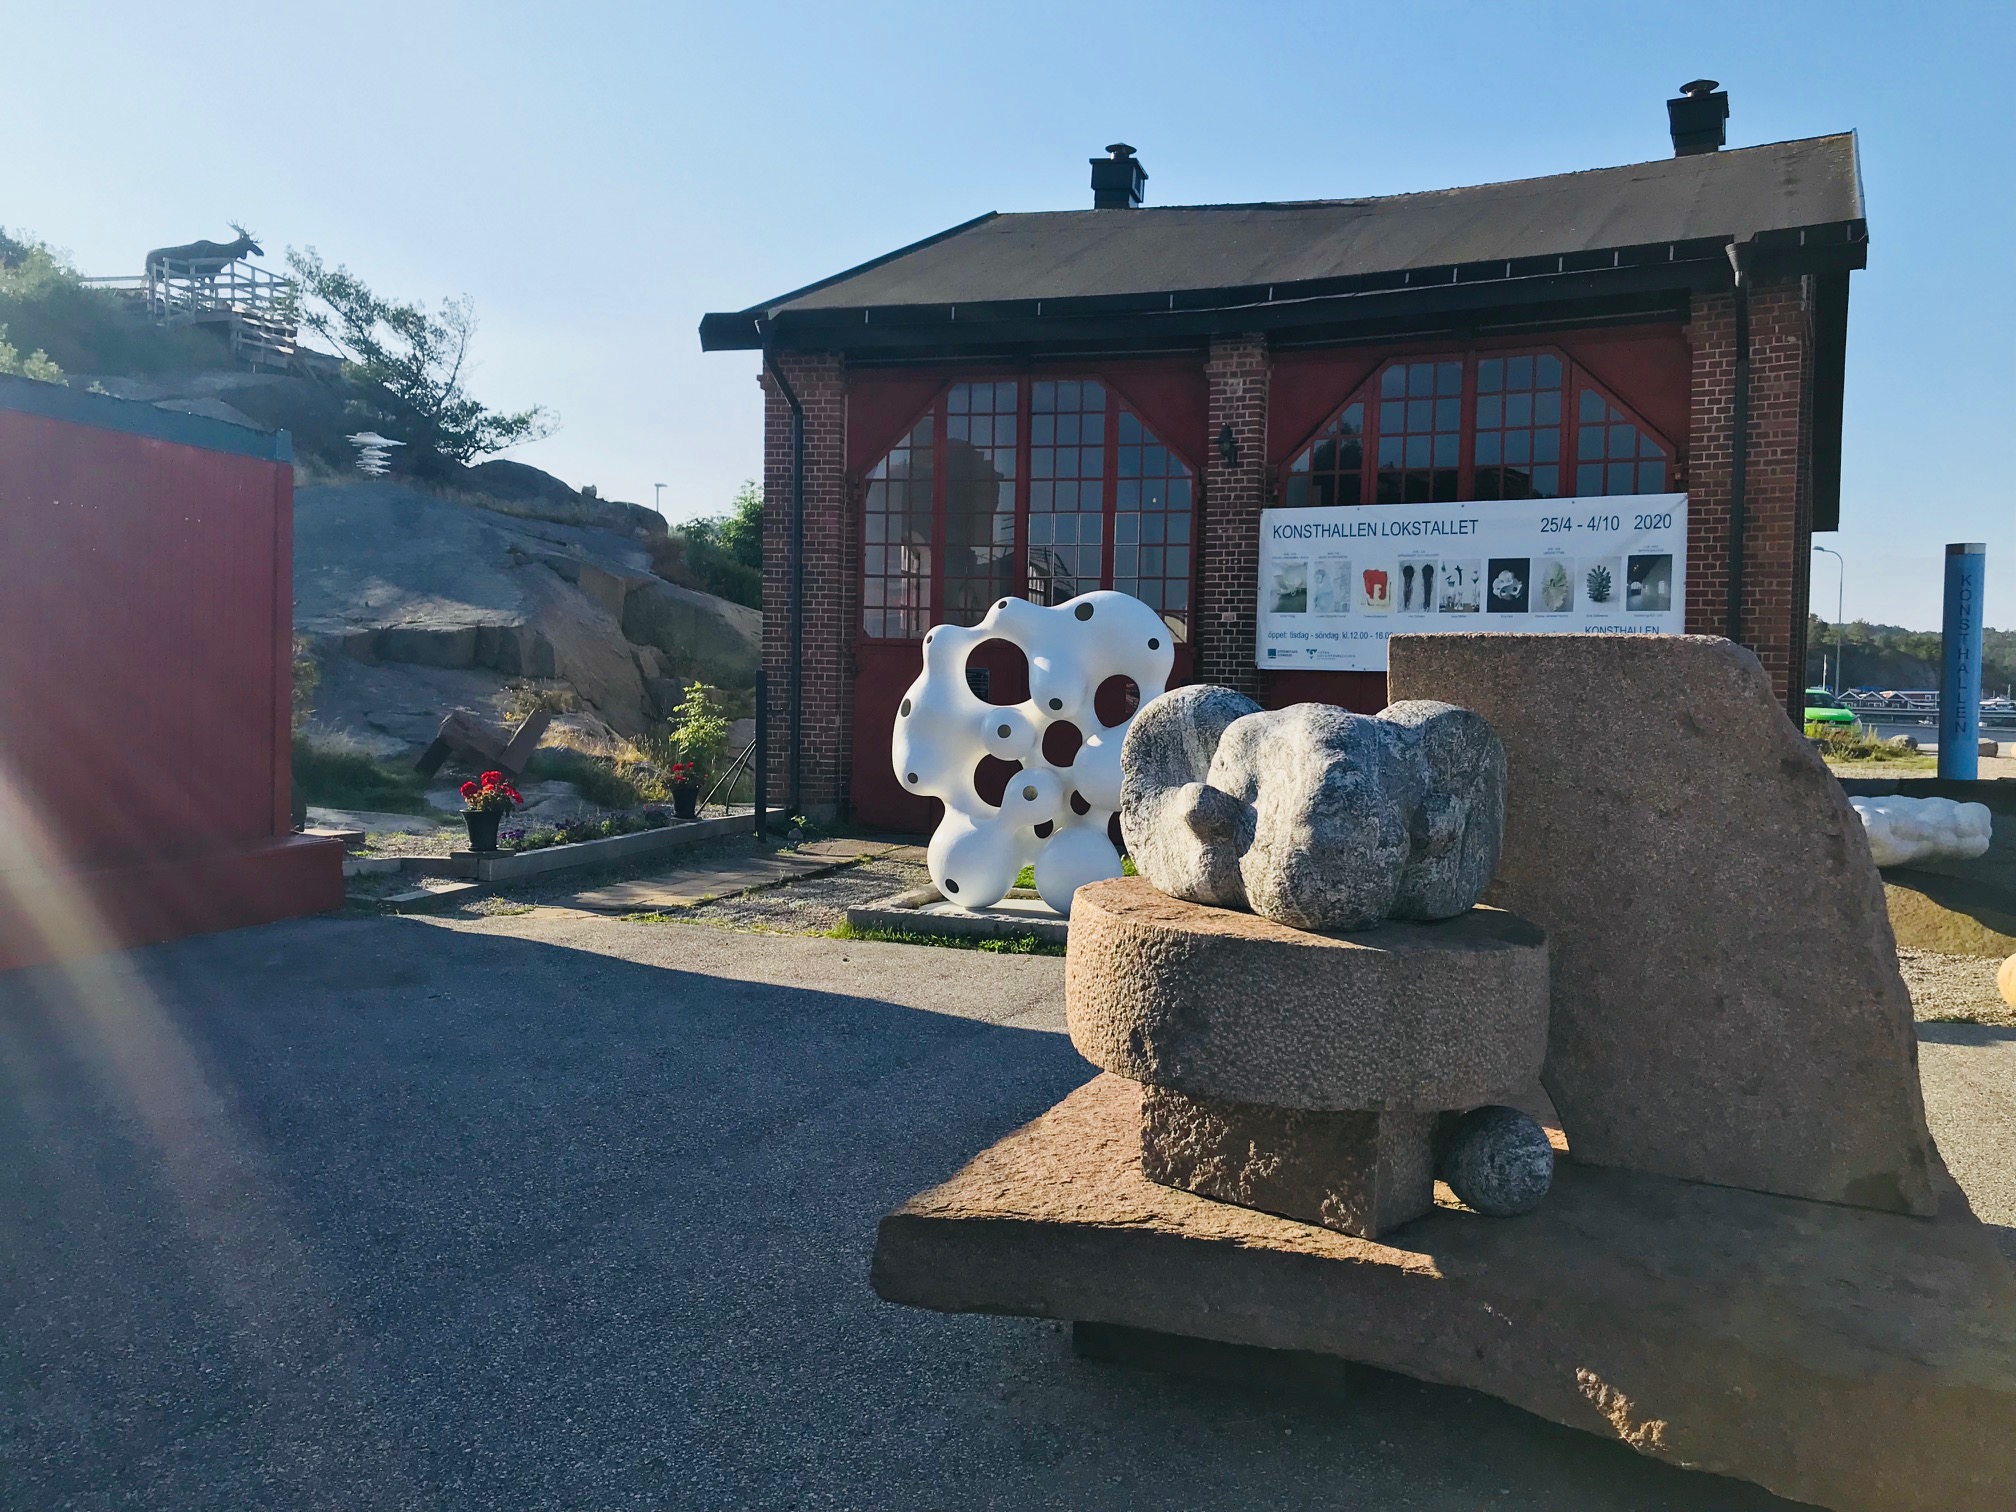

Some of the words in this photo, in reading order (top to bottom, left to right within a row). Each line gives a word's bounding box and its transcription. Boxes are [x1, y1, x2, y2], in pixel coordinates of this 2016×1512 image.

[1273, 522, 1377, 539] KONSTHALLEN
[1381, 519, 1479, 536] LOKSTALLET
[1540, 517, 1573, 533] 25/4
[1586, 515, 1620, 532] 4/10
[1633, 513, 1672, 530] 2020
[1289, 630, 1309, 641] tisdag
[1314, 630, 1339, 641] söndag
[1954, 574, 1972, 734] KONSTHALLEN
